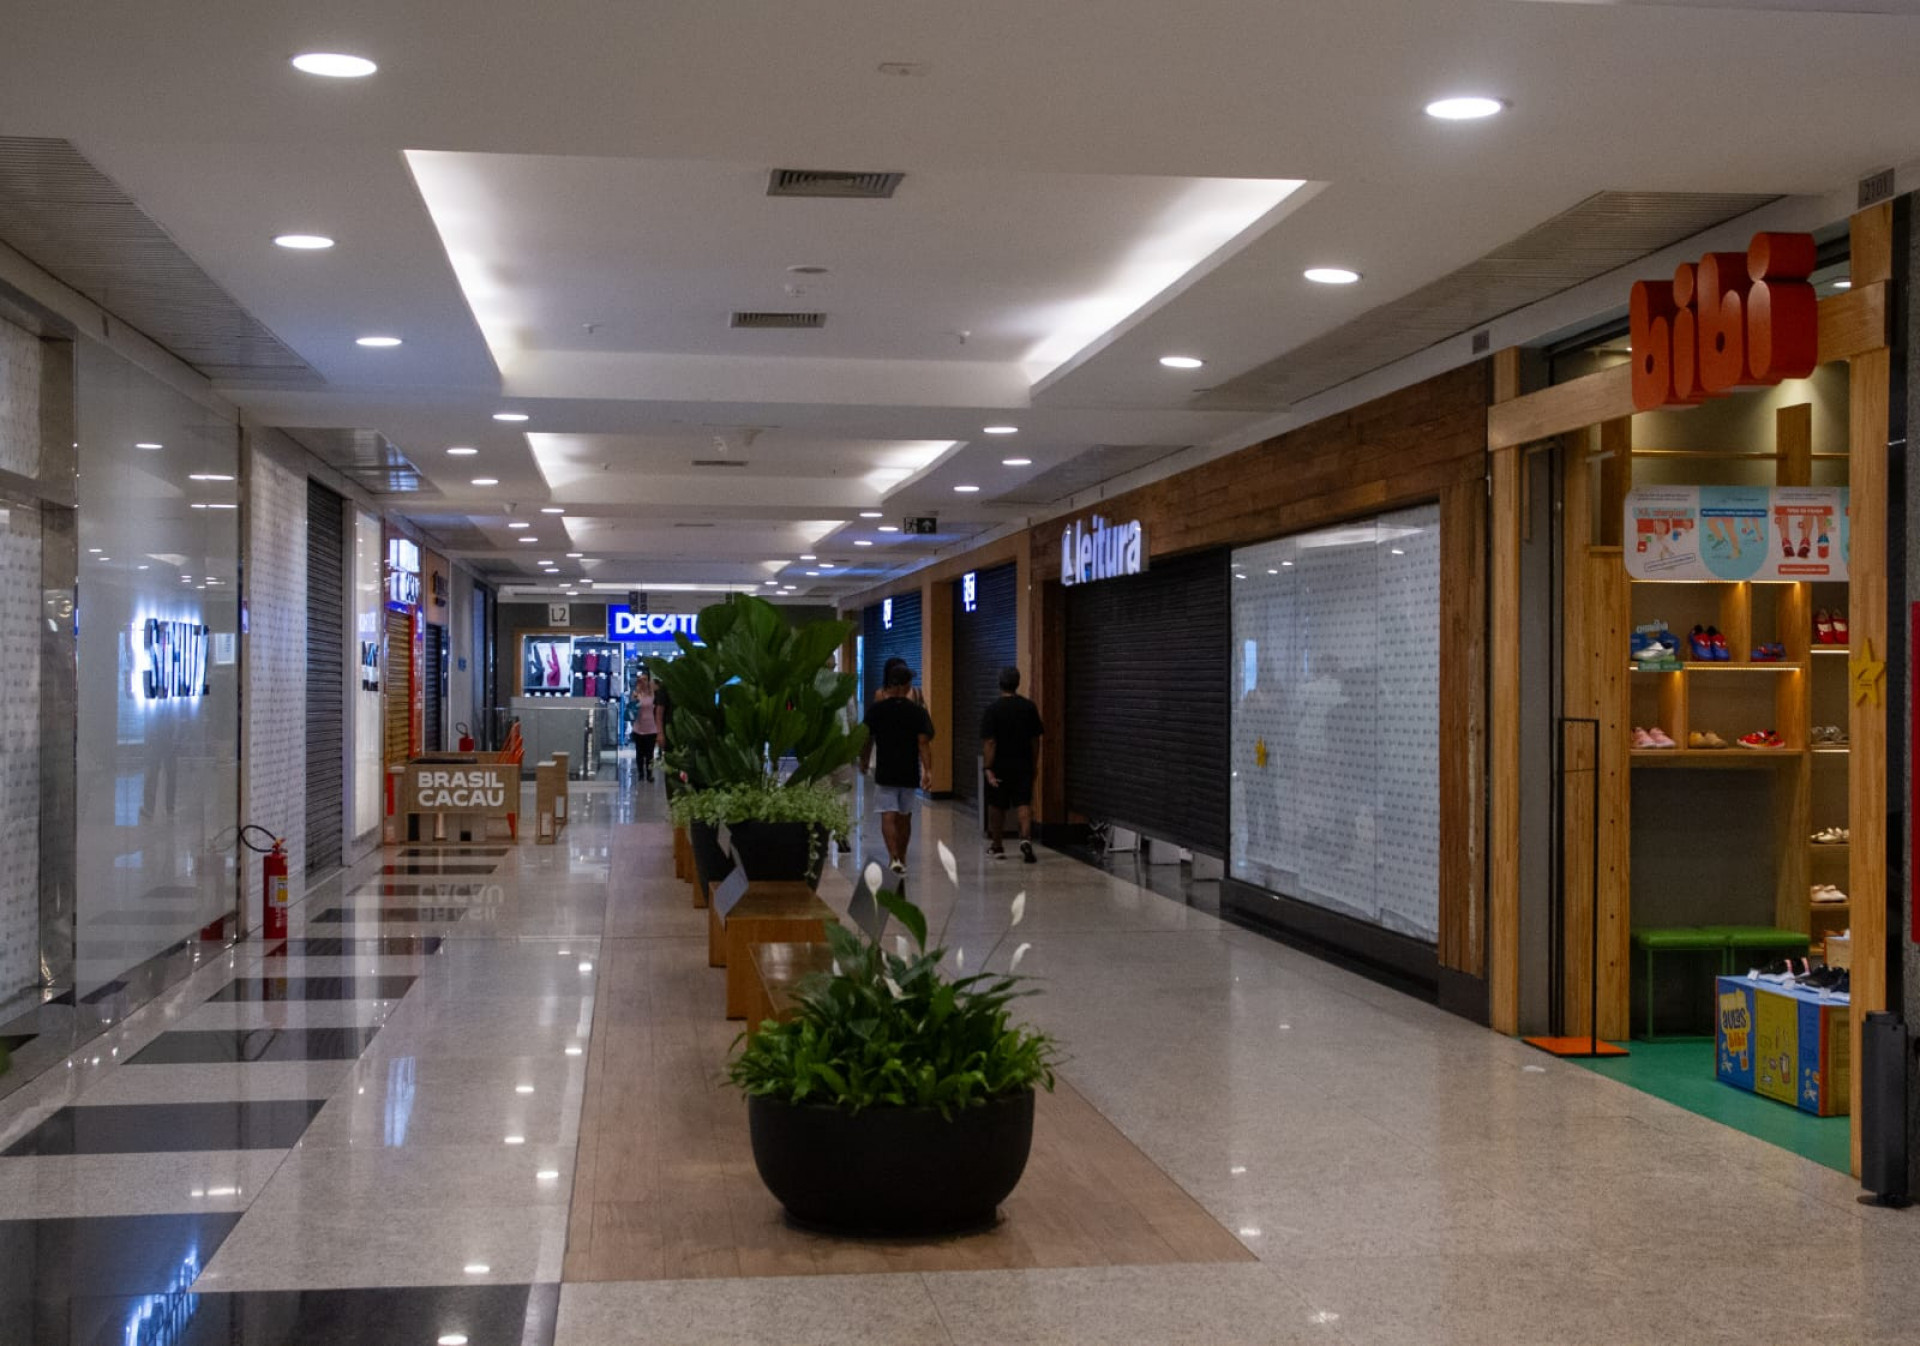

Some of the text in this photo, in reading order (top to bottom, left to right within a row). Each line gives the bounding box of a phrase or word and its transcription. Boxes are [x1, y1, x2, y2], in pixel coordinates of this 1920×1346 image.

[1630, 232, 1775, 411] bibi
[1074, 514, 1141, 584] leitura
[551, 607, 568, 623] L2
[143, 618, 210, 700] SCHUTZ
[418, 771, 505, 788] BRASIL
[418, 789, 505, 807] CACAU
